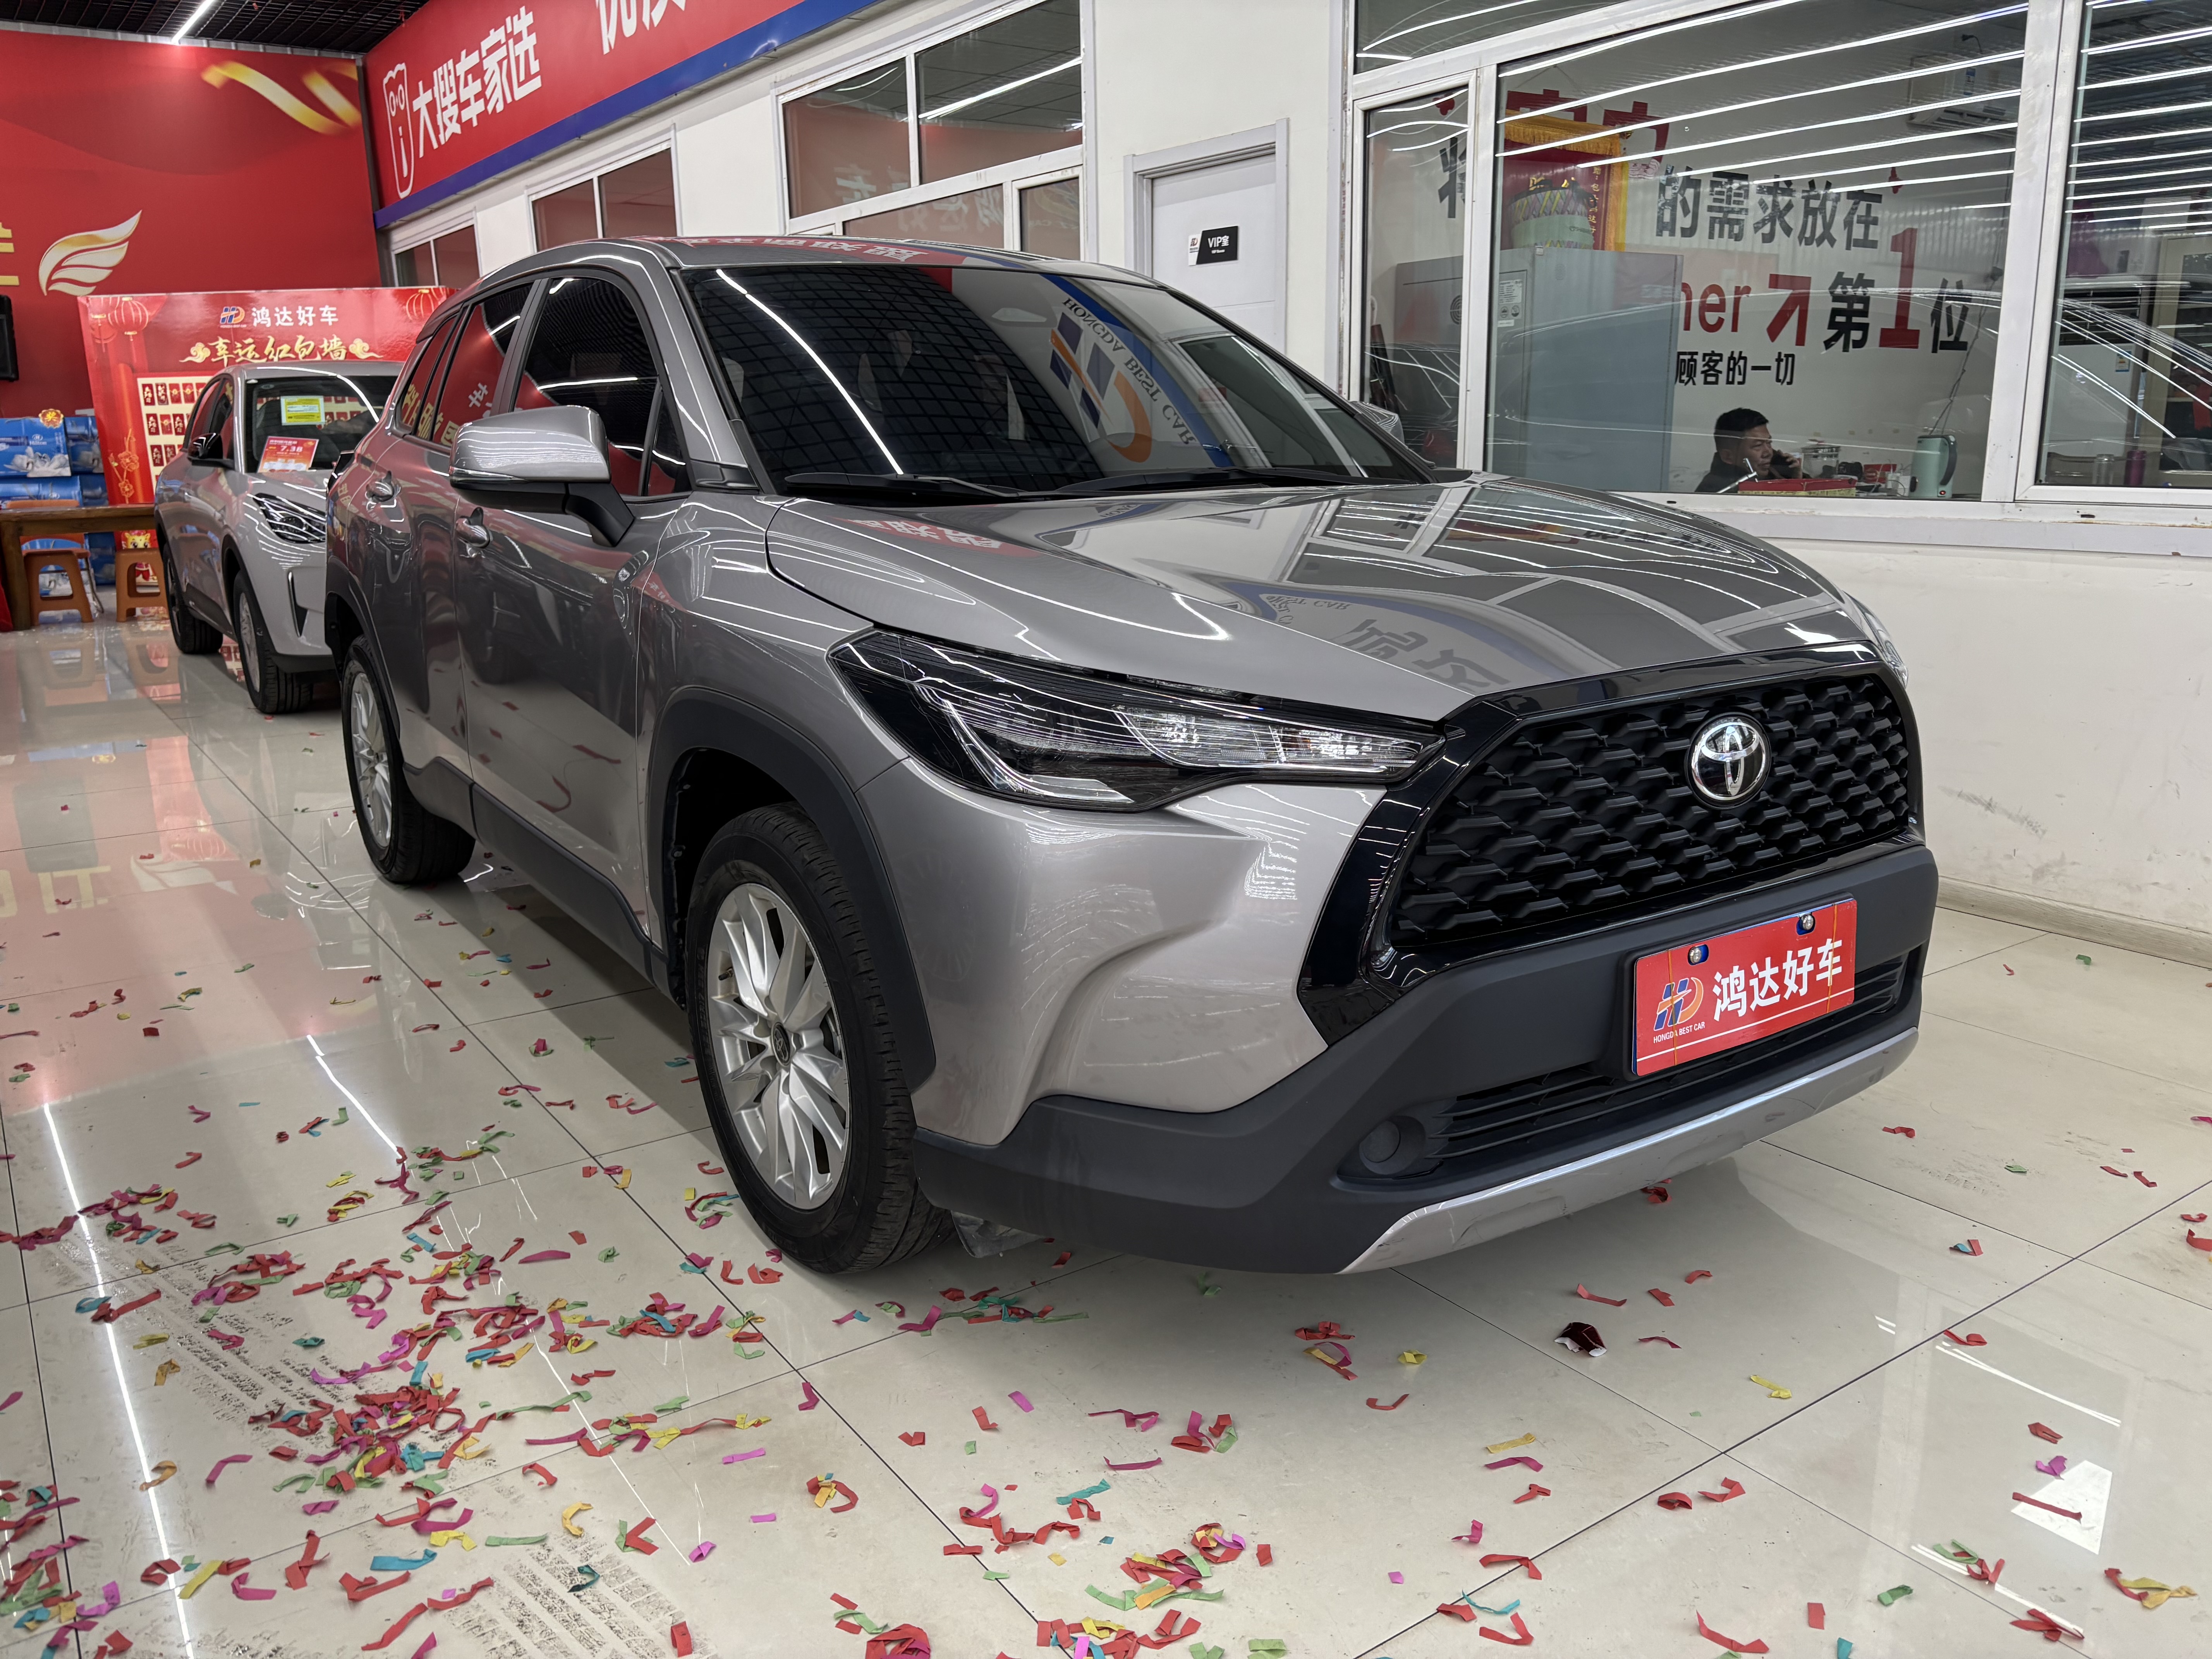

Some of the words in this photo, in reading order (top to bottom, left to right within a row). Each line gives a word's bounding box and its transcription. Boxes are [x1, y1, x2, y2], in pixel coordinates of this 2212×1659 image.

[412, 6, 541, 158] 大搜车家选
[1656, 164, 1882, 251] 的需求放在
[1208, 235, 1230, 248] VIP室
[251, 305, 339, 327] 鸿达好车
[208, 334, 348, 368] 幸运红包墙
[1675, 350, 1795, 386] 顾客的一切
[1712, 938, 1843, 1022] 鸿达好车
[1679, 1025, 1693, 1036] BEST
[1694, 1021, 1705, 1031] CAR
